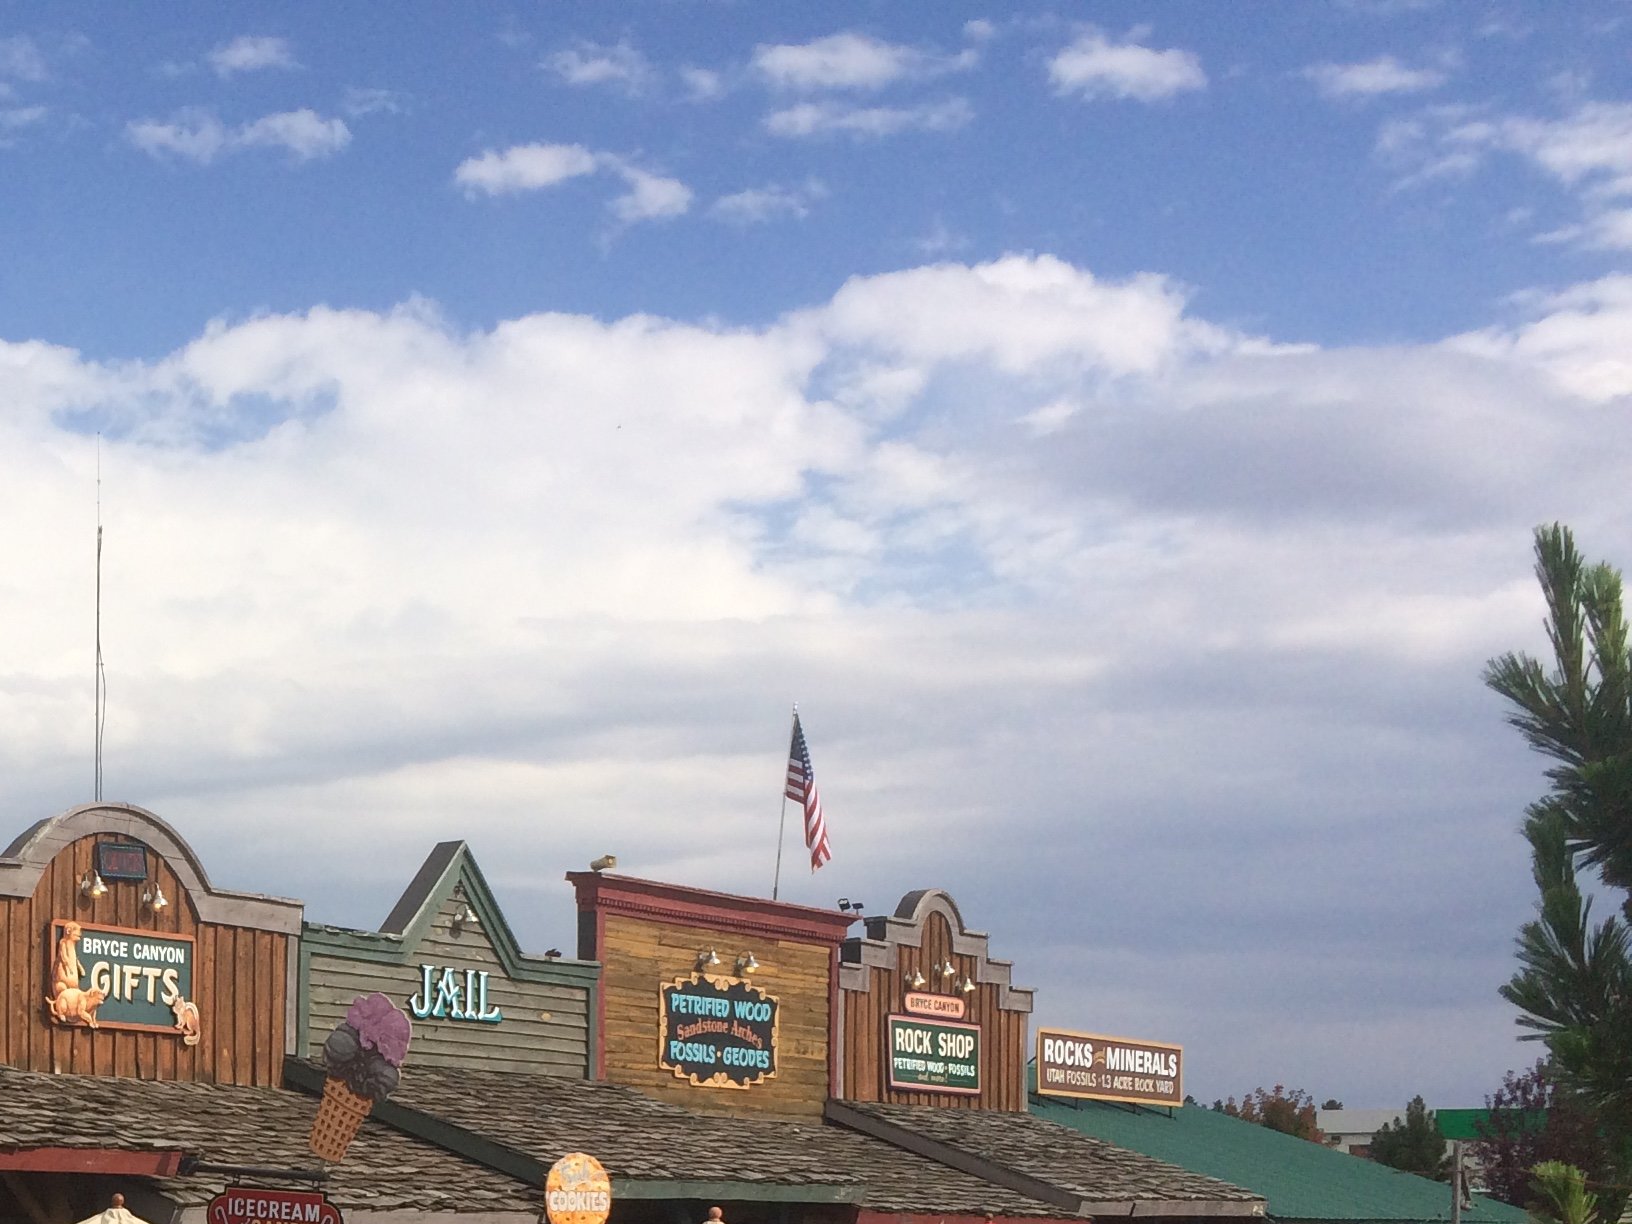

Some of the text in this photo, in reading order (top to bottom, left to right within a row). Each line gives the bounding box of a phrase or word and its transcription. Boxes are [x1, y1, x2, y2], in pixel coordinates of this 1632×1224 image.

[83, 937, 185, 964] BRYCE CANYON
[90, 961, 180, 1006] GIFTS
[409, 964, 503, 1022] JAIL
[671, 993, 772, 1022] PETRIFIED WOOD
[910, 998, 960, 1014] BRYCE CANYON
[676, 1018, 763, 1049] Sandstone Arches
[895, 1027, 974, 1059] ROCK SHOP
[669, 1040, 770, 1069] FOSSILS GEODES
[893, 1057, 976, 1077] PETRIFIED WOOD FOSSILS
[1044, 1038, 1093, 1068] ROCKS
[1106, 1046, 1177, 1078] MINERALS
[1046, 1068, 1066, 1084] UTAH
[1066, 1070, 1097, 1088] FOSSILS
[1113, 1076, 1133, 1091] ACRE
[1134, 1077, 1155, 1093] ROCK
[1155, 1080, 1175, 1095] YARD
[228, 1197, 321, 1223] ICECREAM
[548, 1190, 608, 1212] COOKIES
